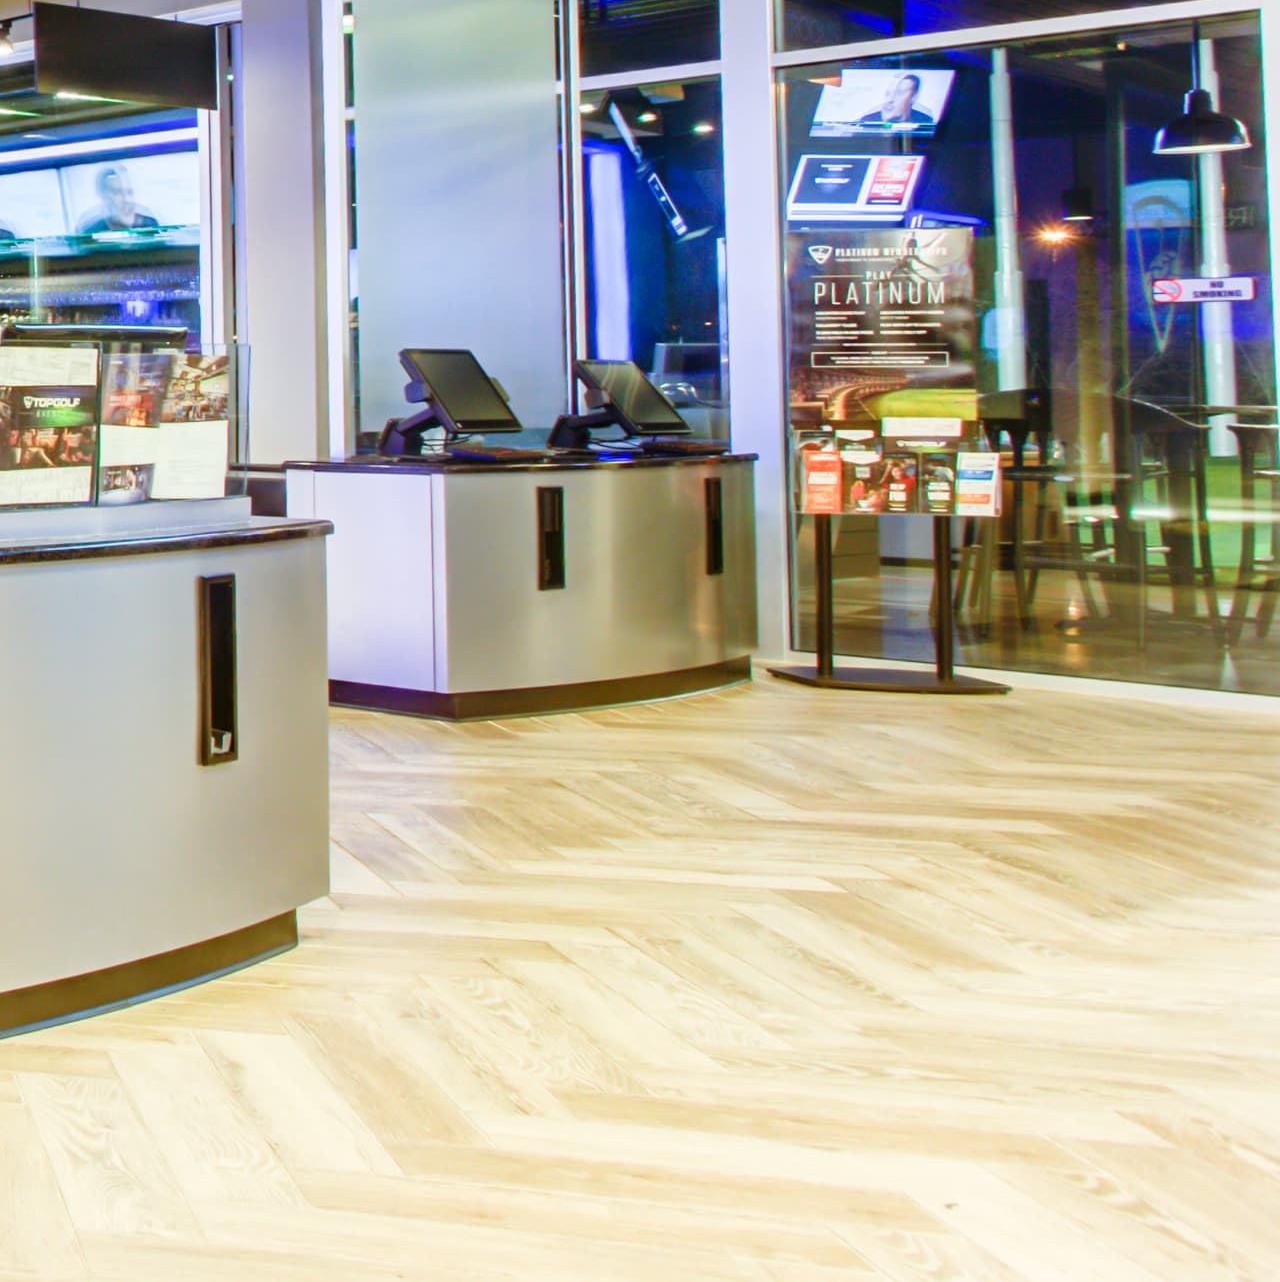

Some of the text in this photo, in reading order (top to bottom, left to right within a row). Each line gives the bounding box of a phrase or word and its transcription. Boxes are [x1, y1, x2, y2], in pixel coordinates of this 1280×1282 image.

[835, 247, 880, 257] PLATINUM
[864, 270, 893, 280] PLAY
[1209, 280, 1225, 289] NO
[813, 281, 946, 305] PLATINUM
[1192, 289, 1243, 299] SMOKING
[33, 396, 80, 408] TOPGOLF
